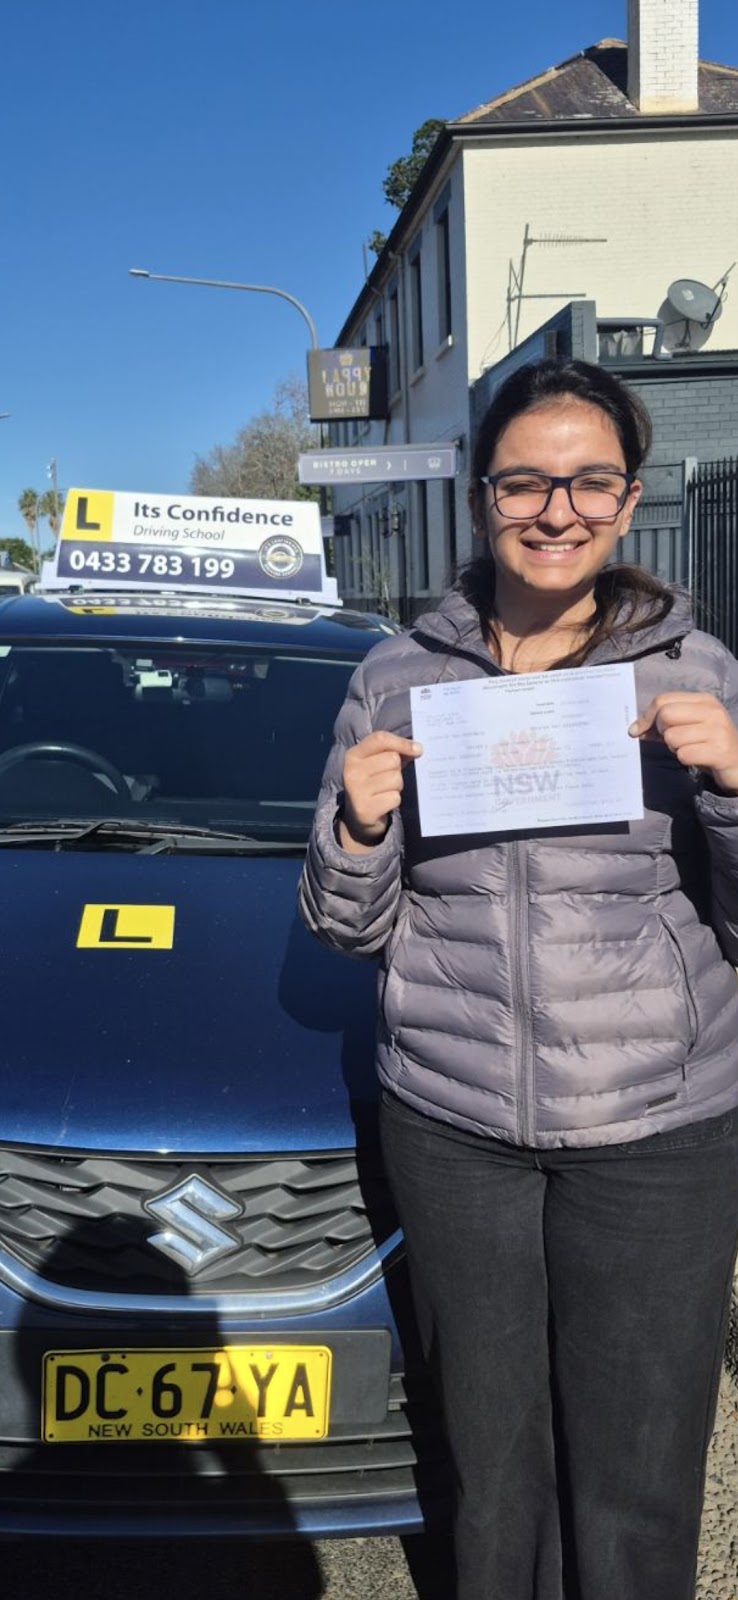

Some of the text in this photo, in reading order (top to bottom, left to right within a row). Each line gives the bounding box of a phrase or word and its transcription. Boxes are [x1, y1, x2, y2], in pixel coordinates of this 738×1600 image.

[76, 497, 100, 531] L
[134, 502, 293, 526] Its Confidence
[133, 525, 226, 541] Driving School
[70, 550, 235, 579] 0433 783 199
[492, 770, 560, 797] NSW
[99, 909, 153, 943] L
[88, 1422, 284, 1438] NEW SOUTH WALES
